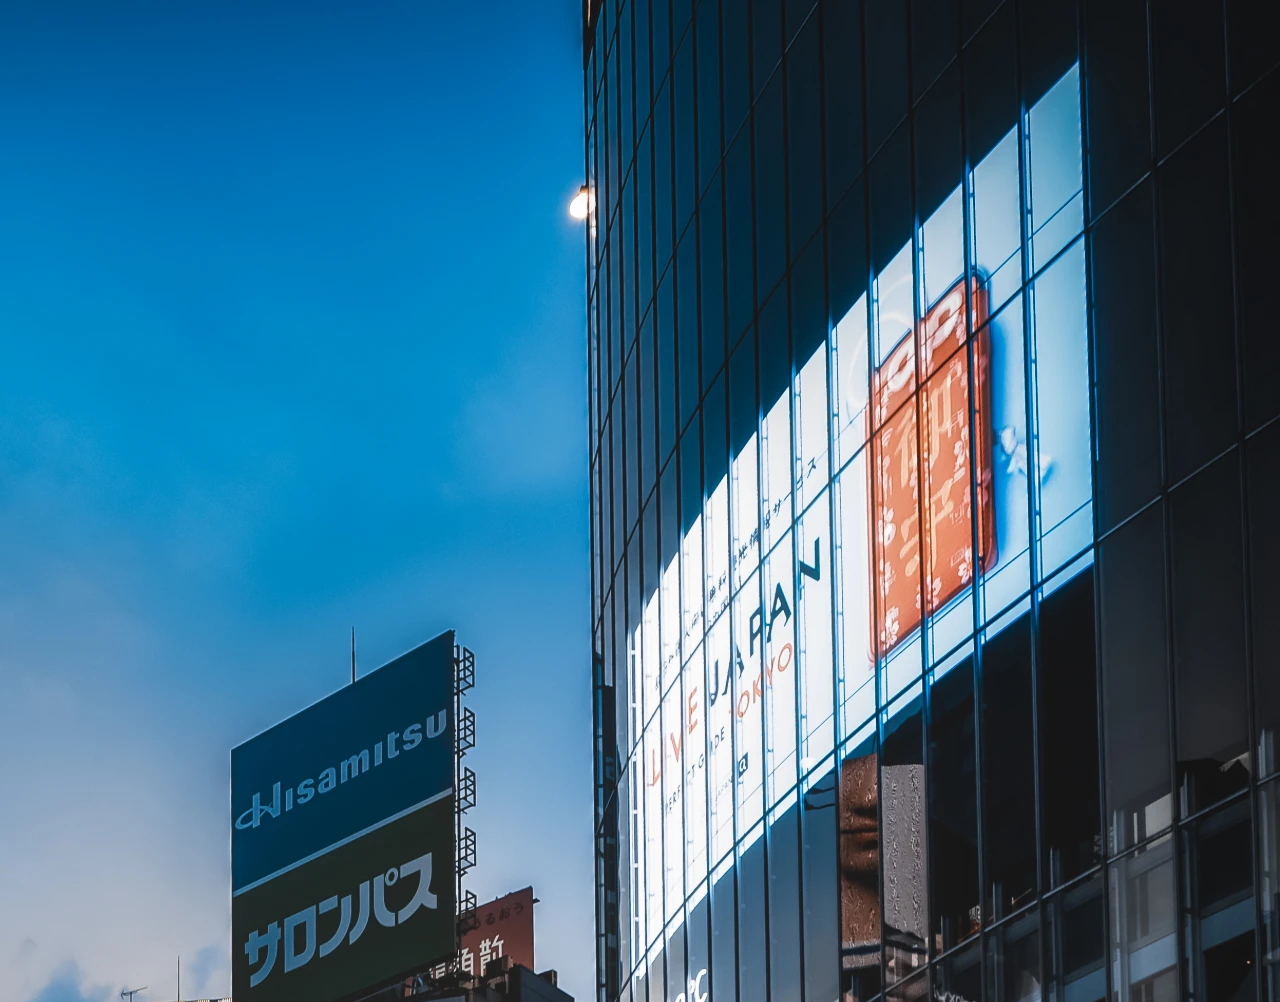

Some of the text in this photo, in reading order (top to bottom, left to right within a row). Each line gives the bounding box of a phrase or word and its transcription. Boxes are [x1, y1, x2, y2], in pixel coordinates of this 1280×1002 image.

[648, 687, 697, 787] LVE
[710, 536, 821, 707] JAPAN
[729, 643, 792, 718] OKYO
[235, 709, 447, 829] Hisamitsu
[245, 852, 438, 988] サロンパス
